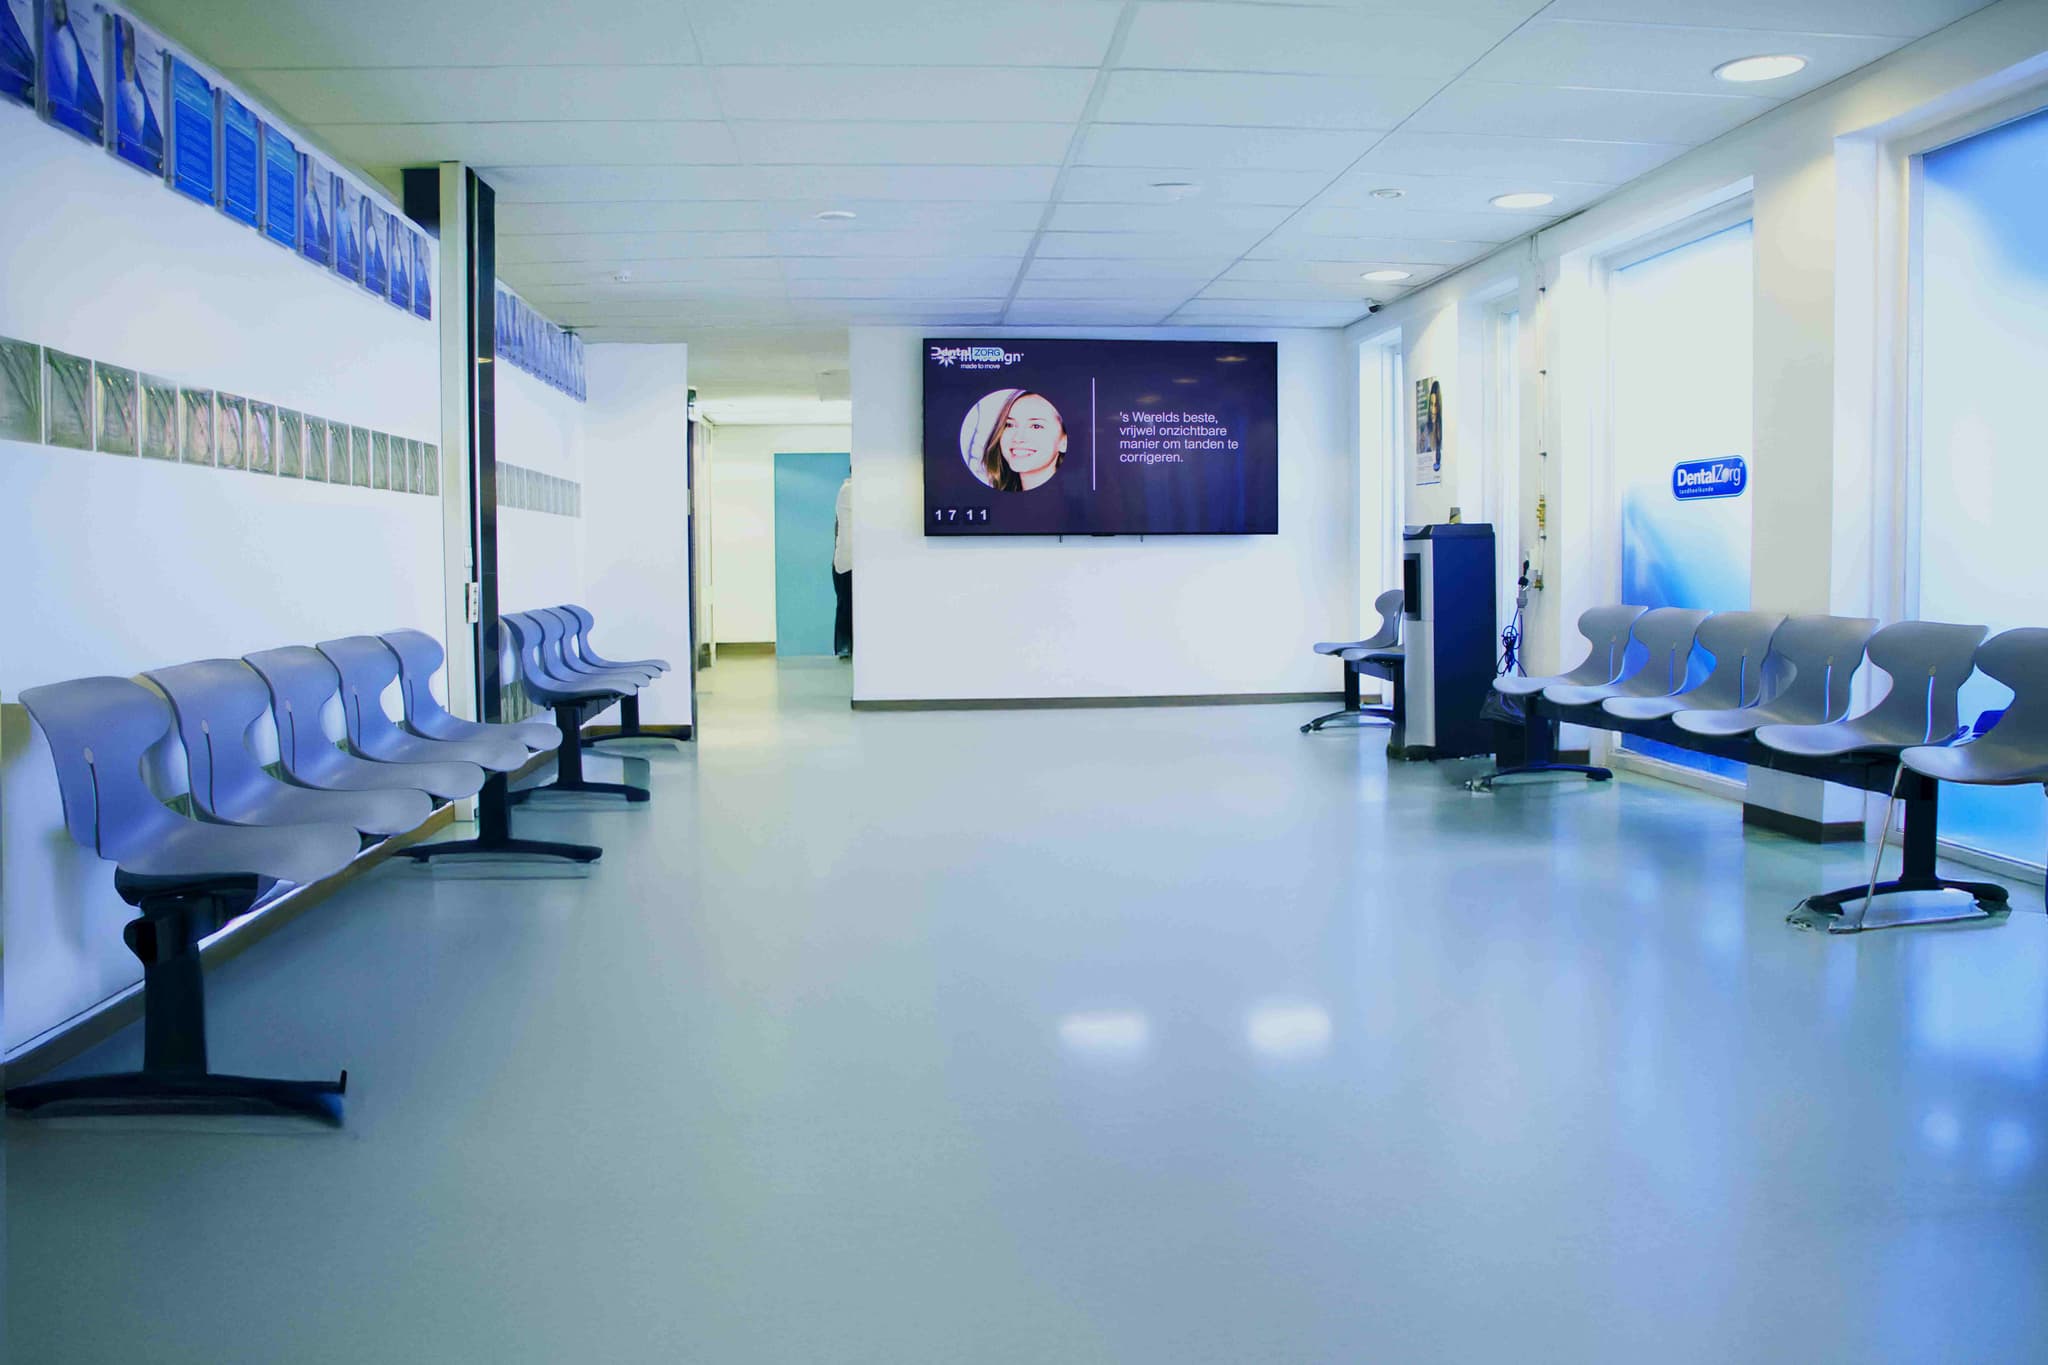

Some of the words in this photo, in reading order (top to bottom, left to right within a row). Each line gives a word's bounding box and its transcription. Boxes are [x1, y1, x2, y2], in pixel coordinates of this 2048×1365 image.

[974, 348, 1001, 356] ZORG
[1132, 411, 1180, 423] Werelds
[1183, 412, 1219, 424] beste,
[1119, 425, 1156, 438] vrijwel
[1159, 425, 1227, 436] onzichtbare
[1119, 439, 1159, 449] manier
[1162, 440, 1181, 449] om
[1184, 439, 1224, 449] tanden
[1227, 439, 1239, 449] te
[1119, 452, 1184, 464] corrigeren.
